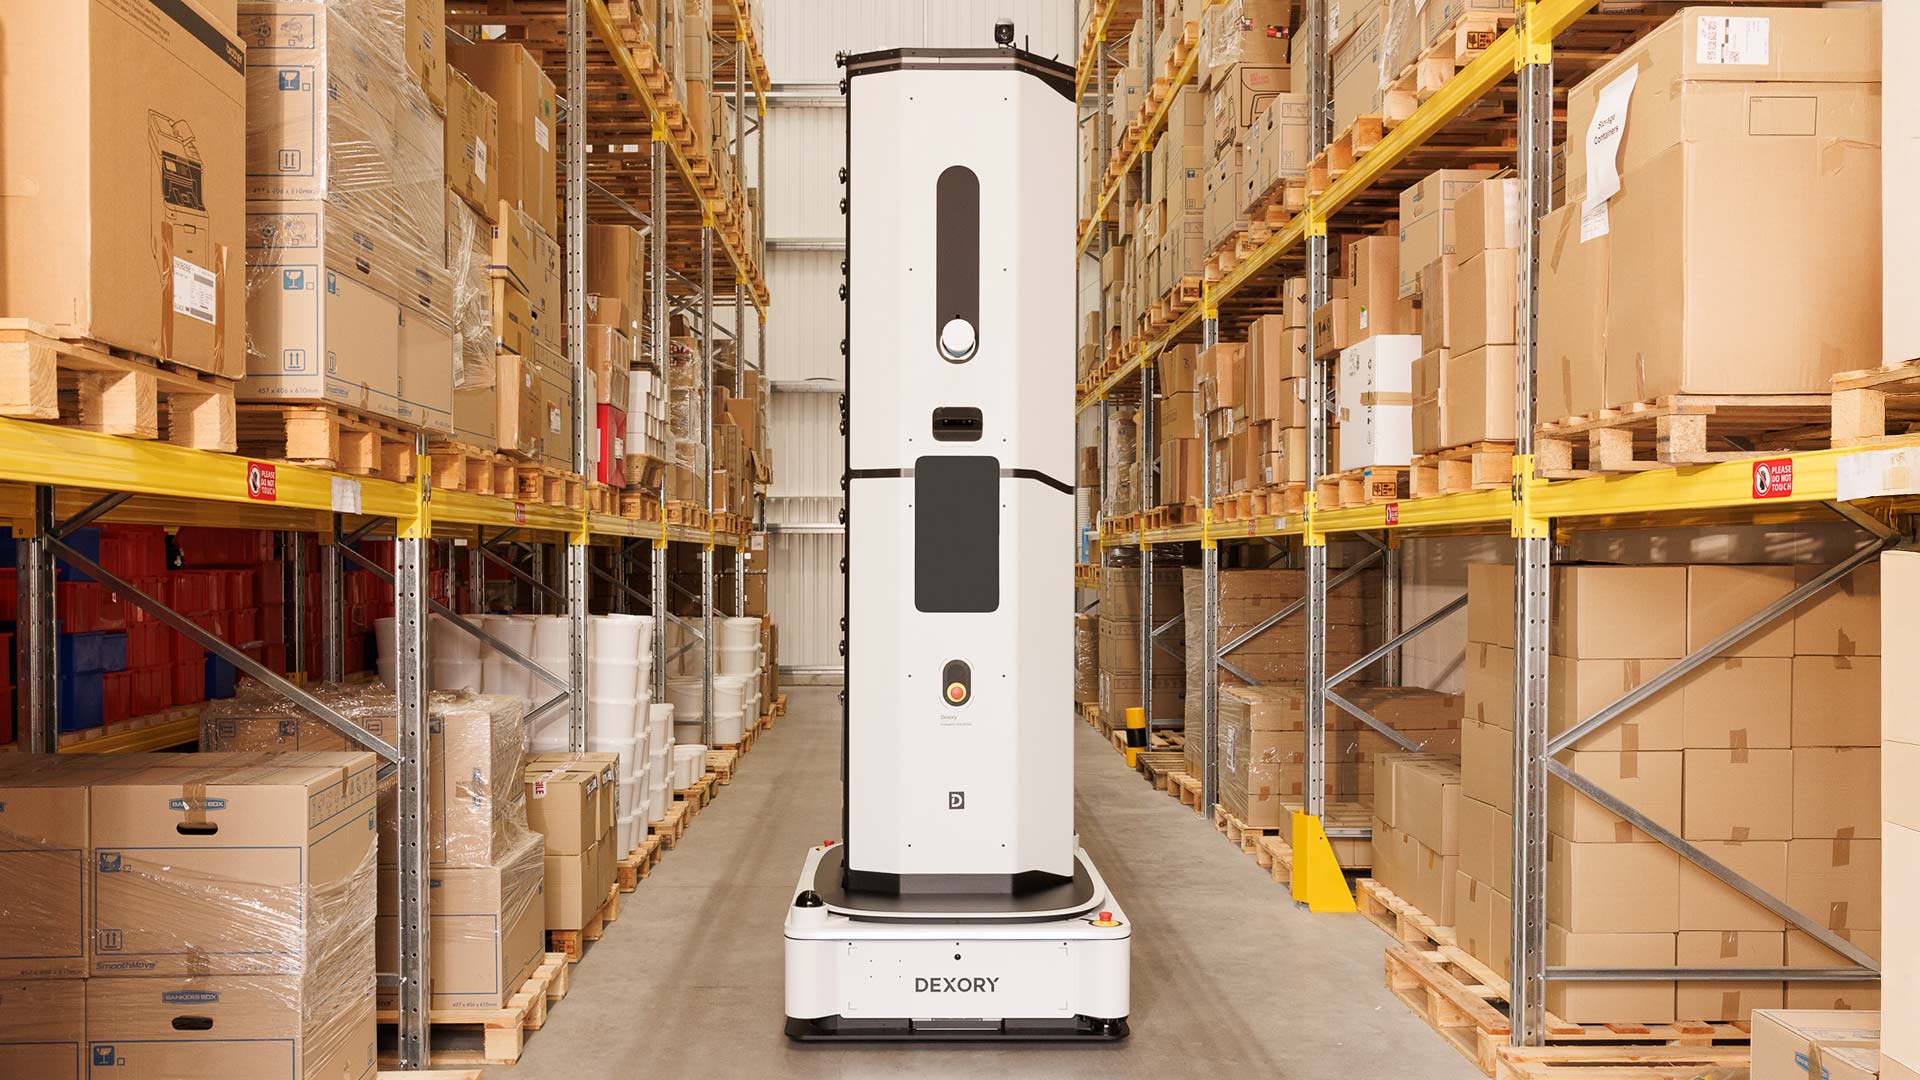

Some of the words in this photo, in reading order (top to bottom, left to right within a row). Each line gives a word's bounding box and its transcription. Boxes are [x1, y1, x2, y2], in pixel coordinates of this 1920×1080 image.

[1597, 113, 1616, 130] Storage
[1594, 125, 1619, 145] Containers
[1771, 465, 1792, 474] PLEASE
[261, 470, 275, 479] PLEASE
[1771, 475, 1780, 483] DO
[1781, 474, 1792, 482] NOT
[267, 479, 275, 487] NOT
[1771, 483, 1792, 492] TOUCH
[261, 487, 275, 495] TOUCH
[915, 977, 999, 993] DEXORY
